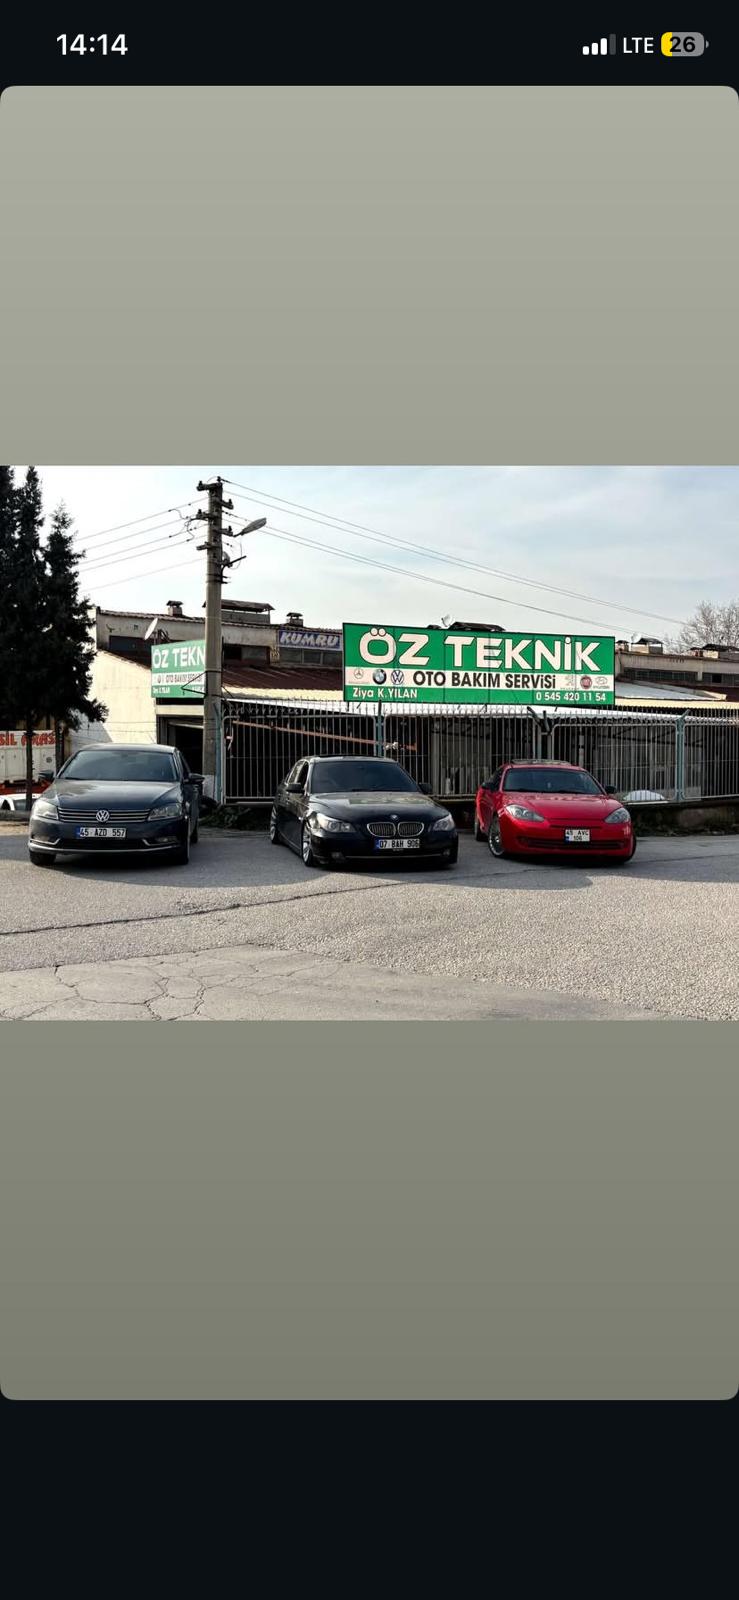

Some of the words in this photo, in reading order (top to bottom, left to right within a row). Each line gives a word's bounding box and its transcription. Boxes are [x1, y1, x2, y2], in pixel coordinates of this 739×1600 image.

[279, 632, 339, 647] KUMRU
[359, 627, 430, 666] ÖZ
[444, 635, 601, 672] TEKNİK
[413, 670, 446, 687] OTO
[451, 671, 500, 690] BAKIM
[352, 687, 374, 699] Ziya
[377, 688, 418, 699] K.YILAN
[535, 691, 541, 700] 0
[543, 692, 561, 701] 545
[563, 692, 580, 701] 420
[583, 693, 592, 701] 11
[595, 693, 606, 702] 54
[80, 828, 89, 836] 45
[94, 828, 107, 837] AZD
[112, 828, 125, 837] 557
[379, 840, 388, 848] 07
